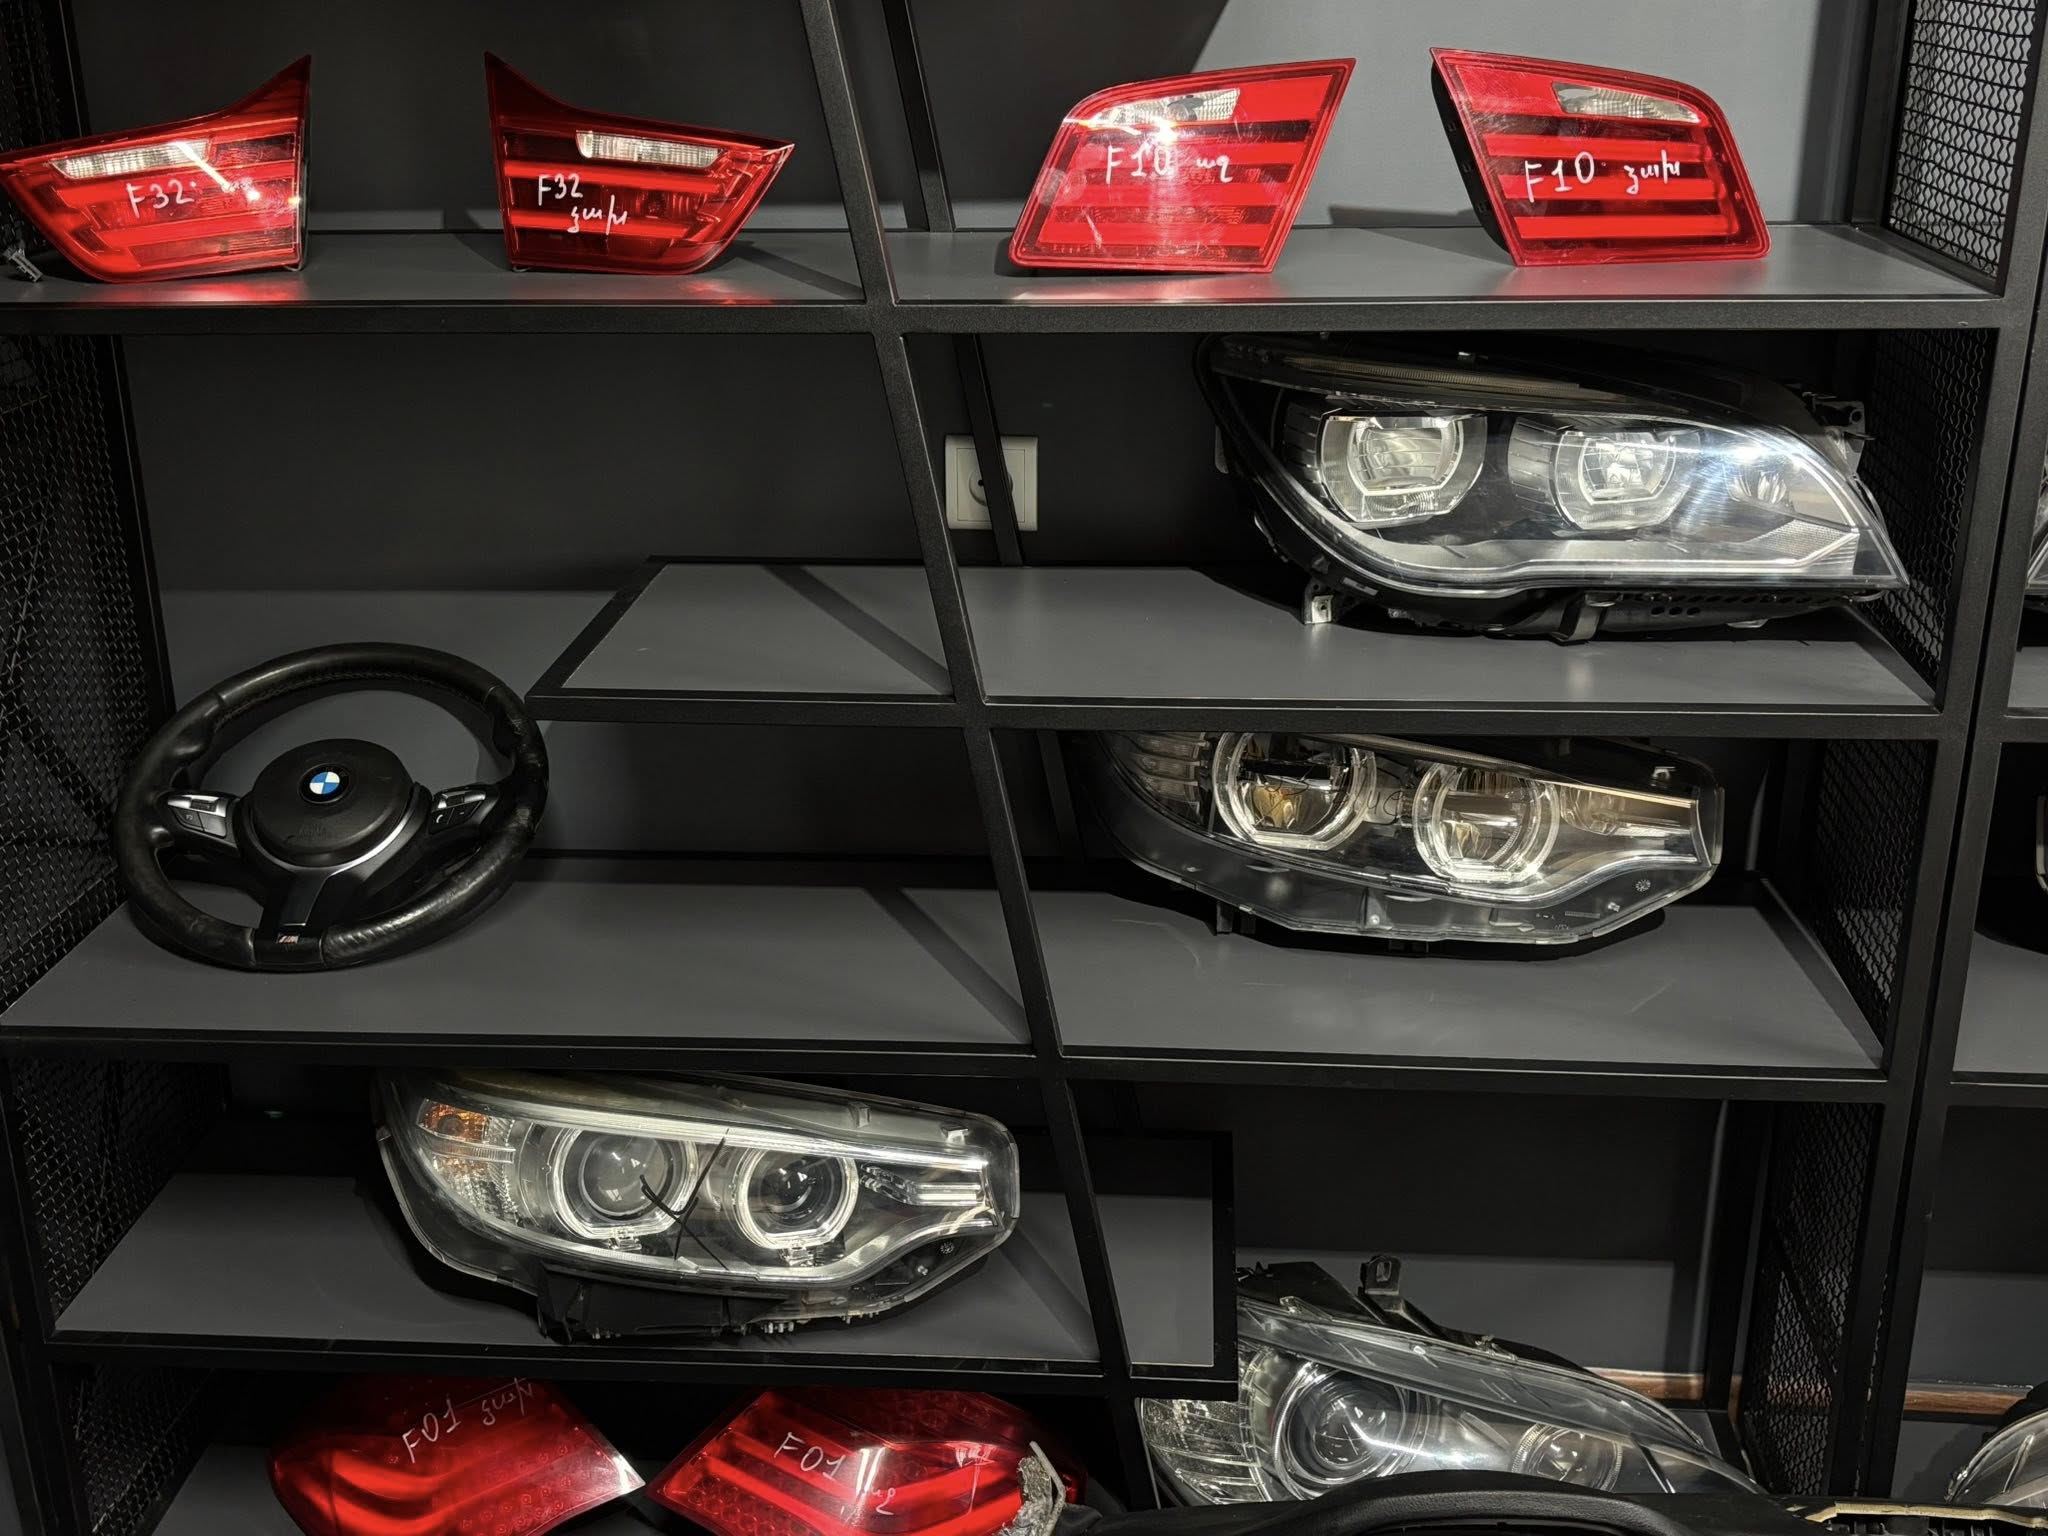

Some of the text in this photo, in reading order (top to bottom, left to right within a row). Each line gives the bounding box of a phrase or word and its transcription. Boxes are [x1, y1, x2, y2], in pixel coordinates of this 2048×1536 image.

[537, 172, 584, 206] F32
[1105, 143, 1171, 185] F10
[1524, 151, 1595, 203] F10
[402, 1398, 462, 1464] F01
[774, 1431, 846, 1482] F01
